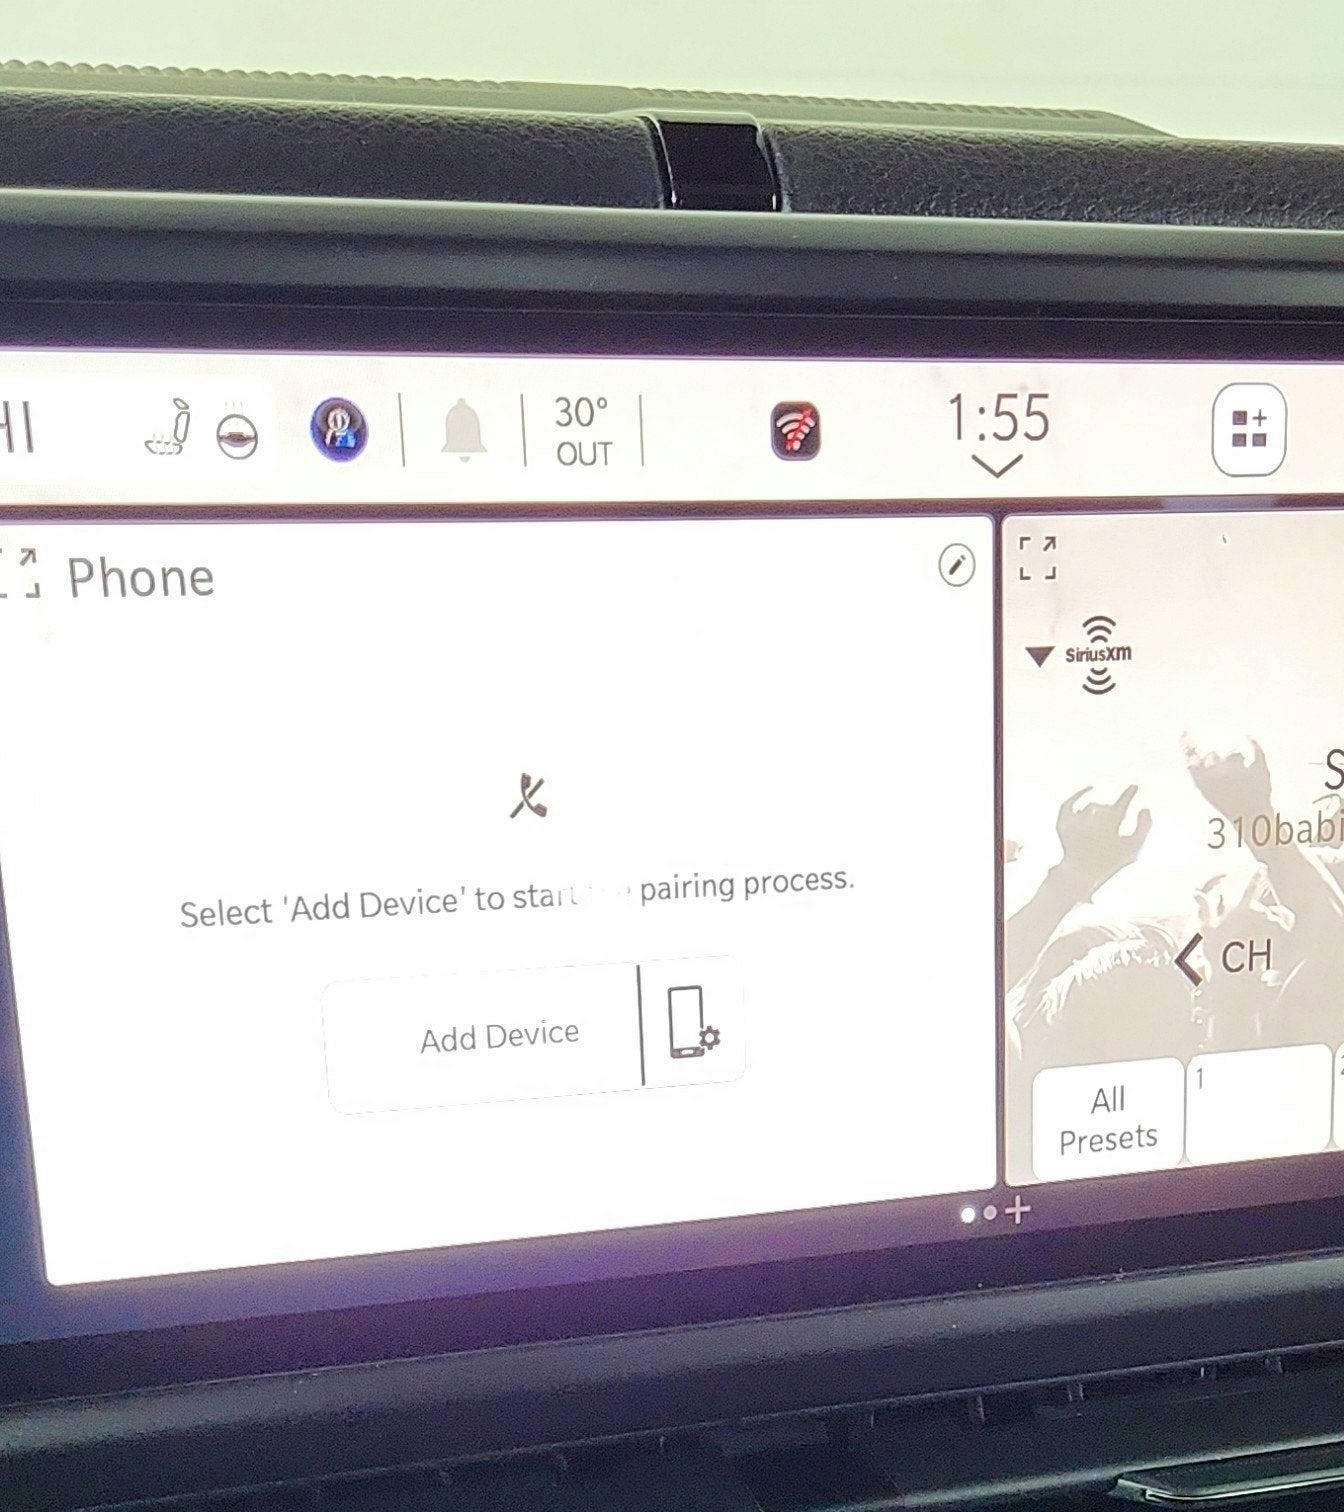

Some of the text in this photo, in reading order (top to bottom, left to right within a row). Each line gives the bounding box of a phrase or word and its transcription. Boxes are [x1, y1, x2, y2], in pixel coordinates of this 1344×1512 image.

[555, 396, 608, 428] 30°
[948, 393, 1050, 442] 1:55
[557, 442, 613, 468] OUT
[68, 557, 215, 600] Phone
[179, 898, 273, 929] Select
[475, 884, 505, 911] to
[640, 872, 735, 908] pairing
[743, 867, 855, 902] process.
[1221, 937, 1273, 974] CH
[419, 1019, 580, 1055] Add Device
[1196, 1067, 1204, 1090] 1
[1091, 1085, 1126, 1115] All
[1059, 1123, 1159, 1156] Presets
